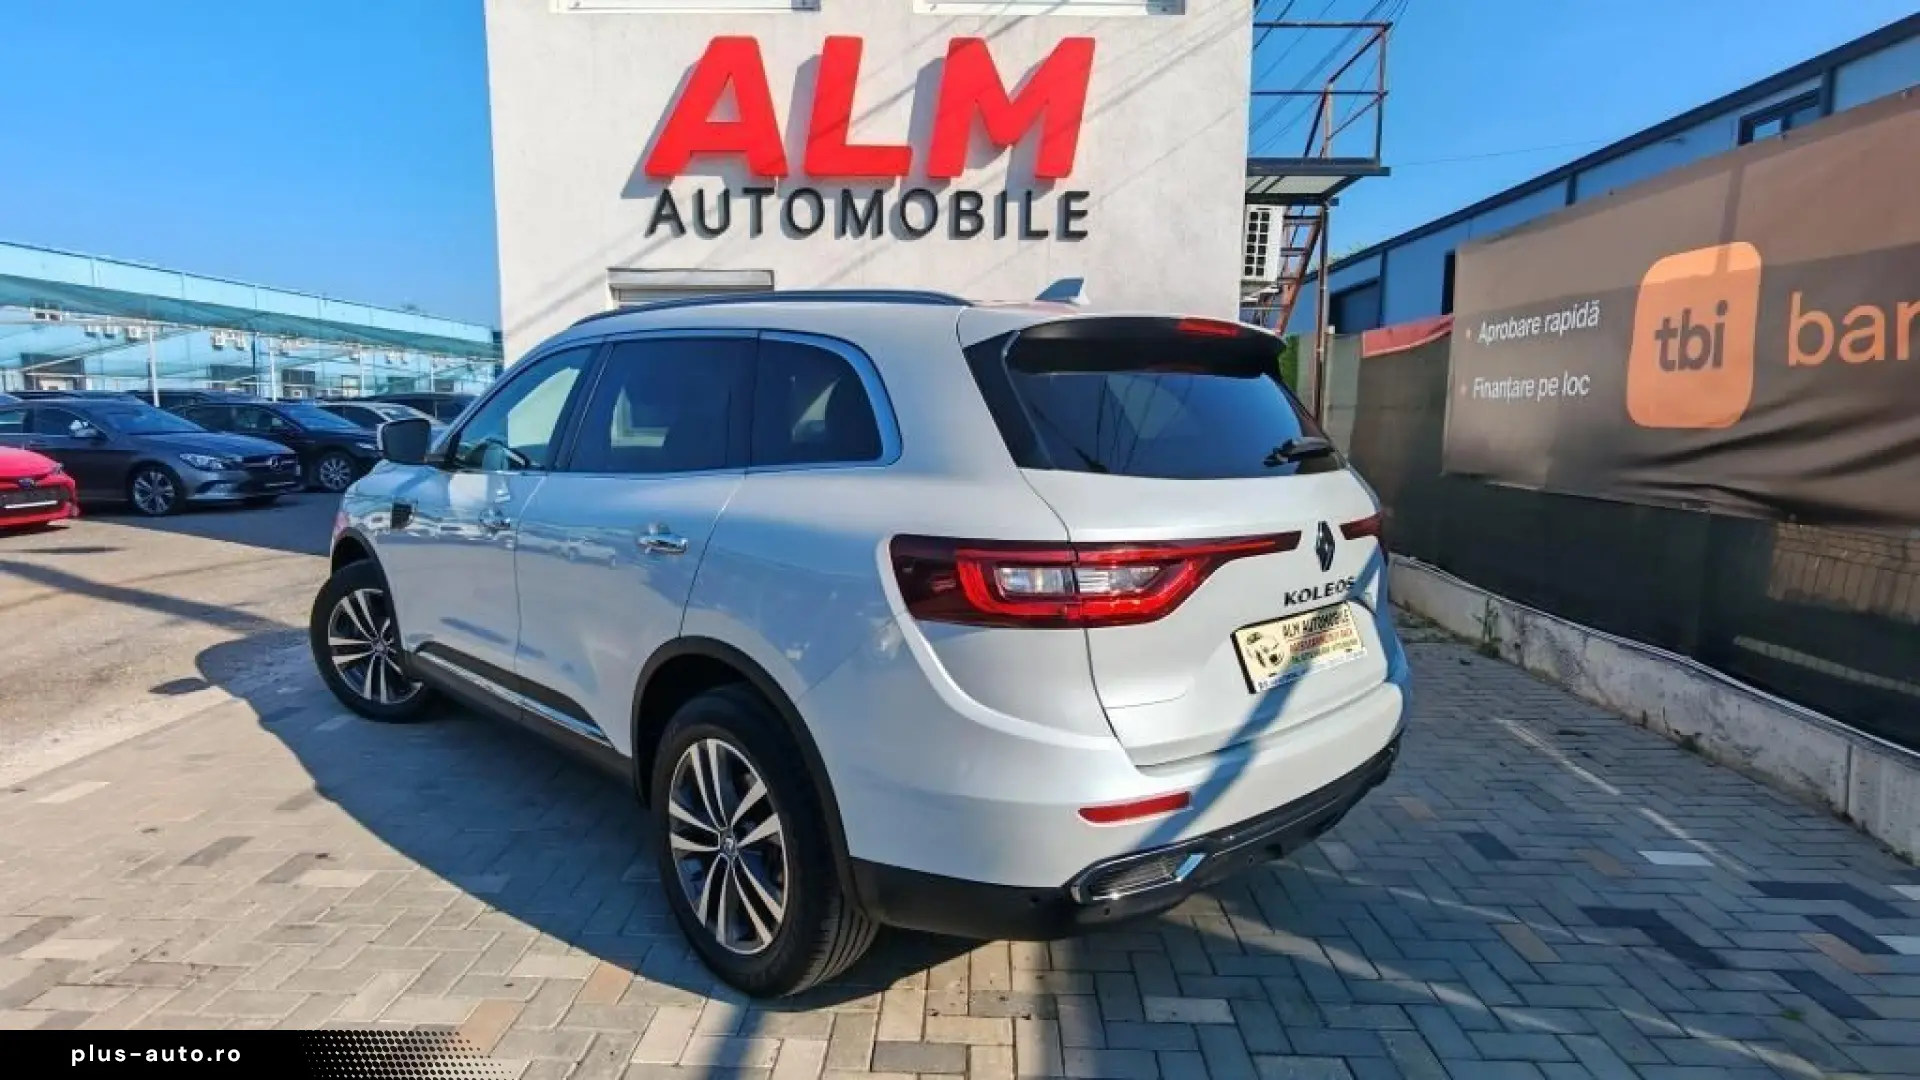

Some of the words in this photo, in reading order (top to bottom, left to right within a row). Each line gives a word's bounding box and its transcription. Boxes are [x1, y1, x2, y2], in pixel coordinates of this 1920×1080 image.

[645, 36, 1095, 179] ALM
[645, 188, 1089, 240] AUTOMOBILE
[1478, 317, 1541, 346] Aprobare
[1544, 299, 1600, 337] rapidă
[1654, 300, 1728, 372] tbi
[1537, 376, 1559, 402] pe
[1561, 370, 1591, 397] loc
